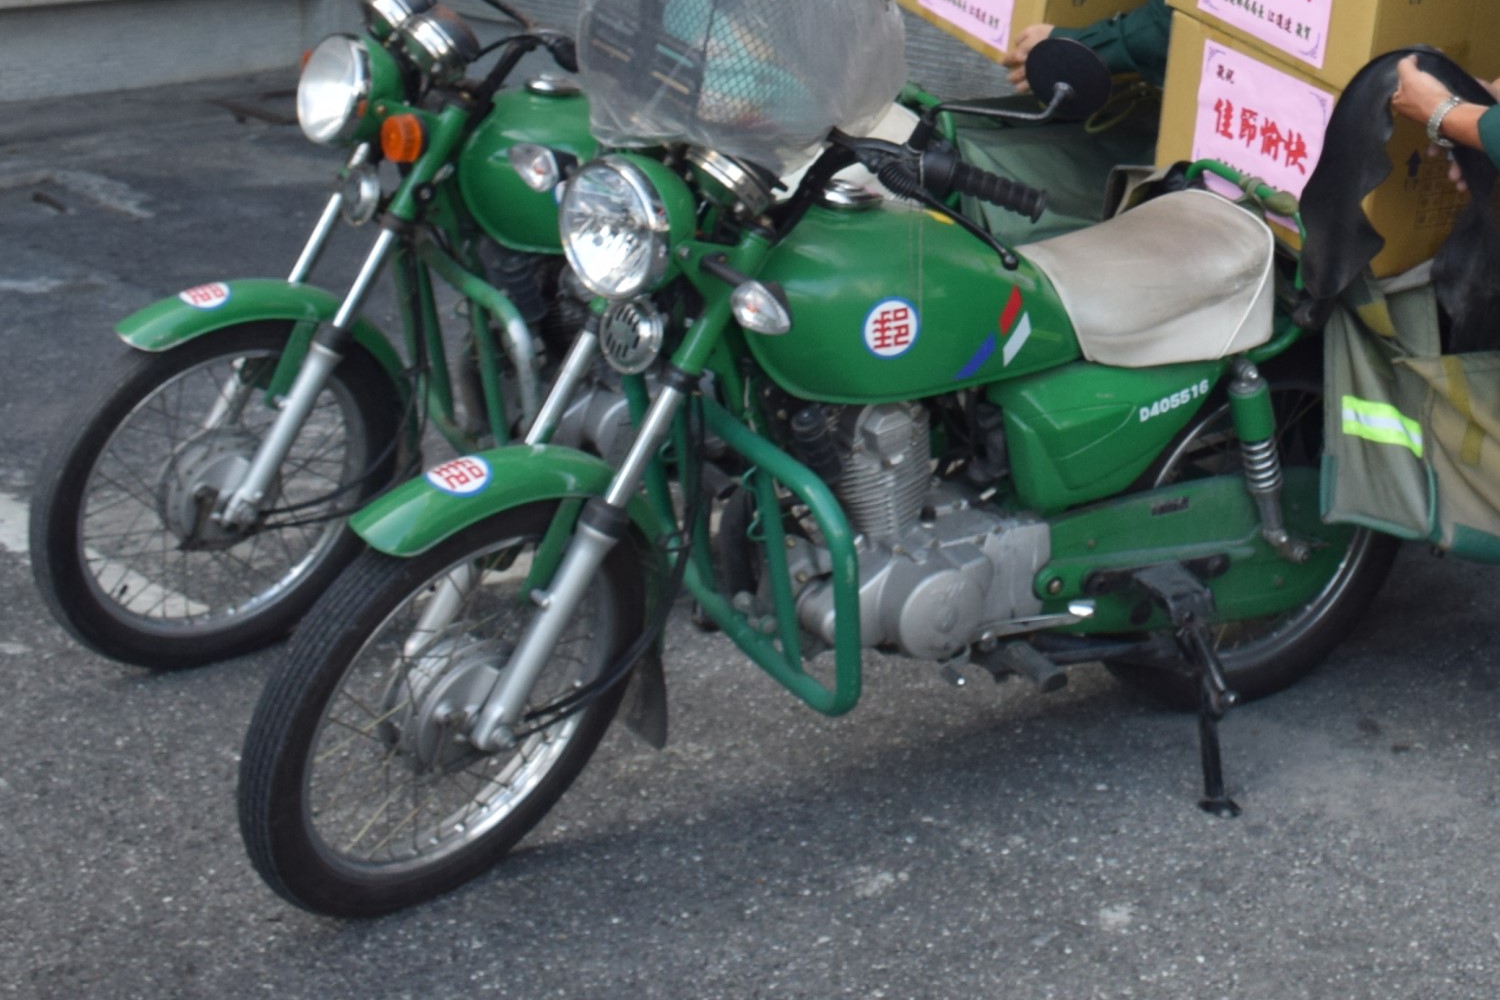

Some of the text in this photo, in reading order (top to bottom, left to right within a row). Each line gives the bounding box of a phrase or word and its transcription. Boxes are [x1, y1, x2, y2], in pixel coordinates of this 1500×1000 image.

[1213, 97, 1308, 175] 佳節愉快
[1139, 378, 1209, 422] D405516
